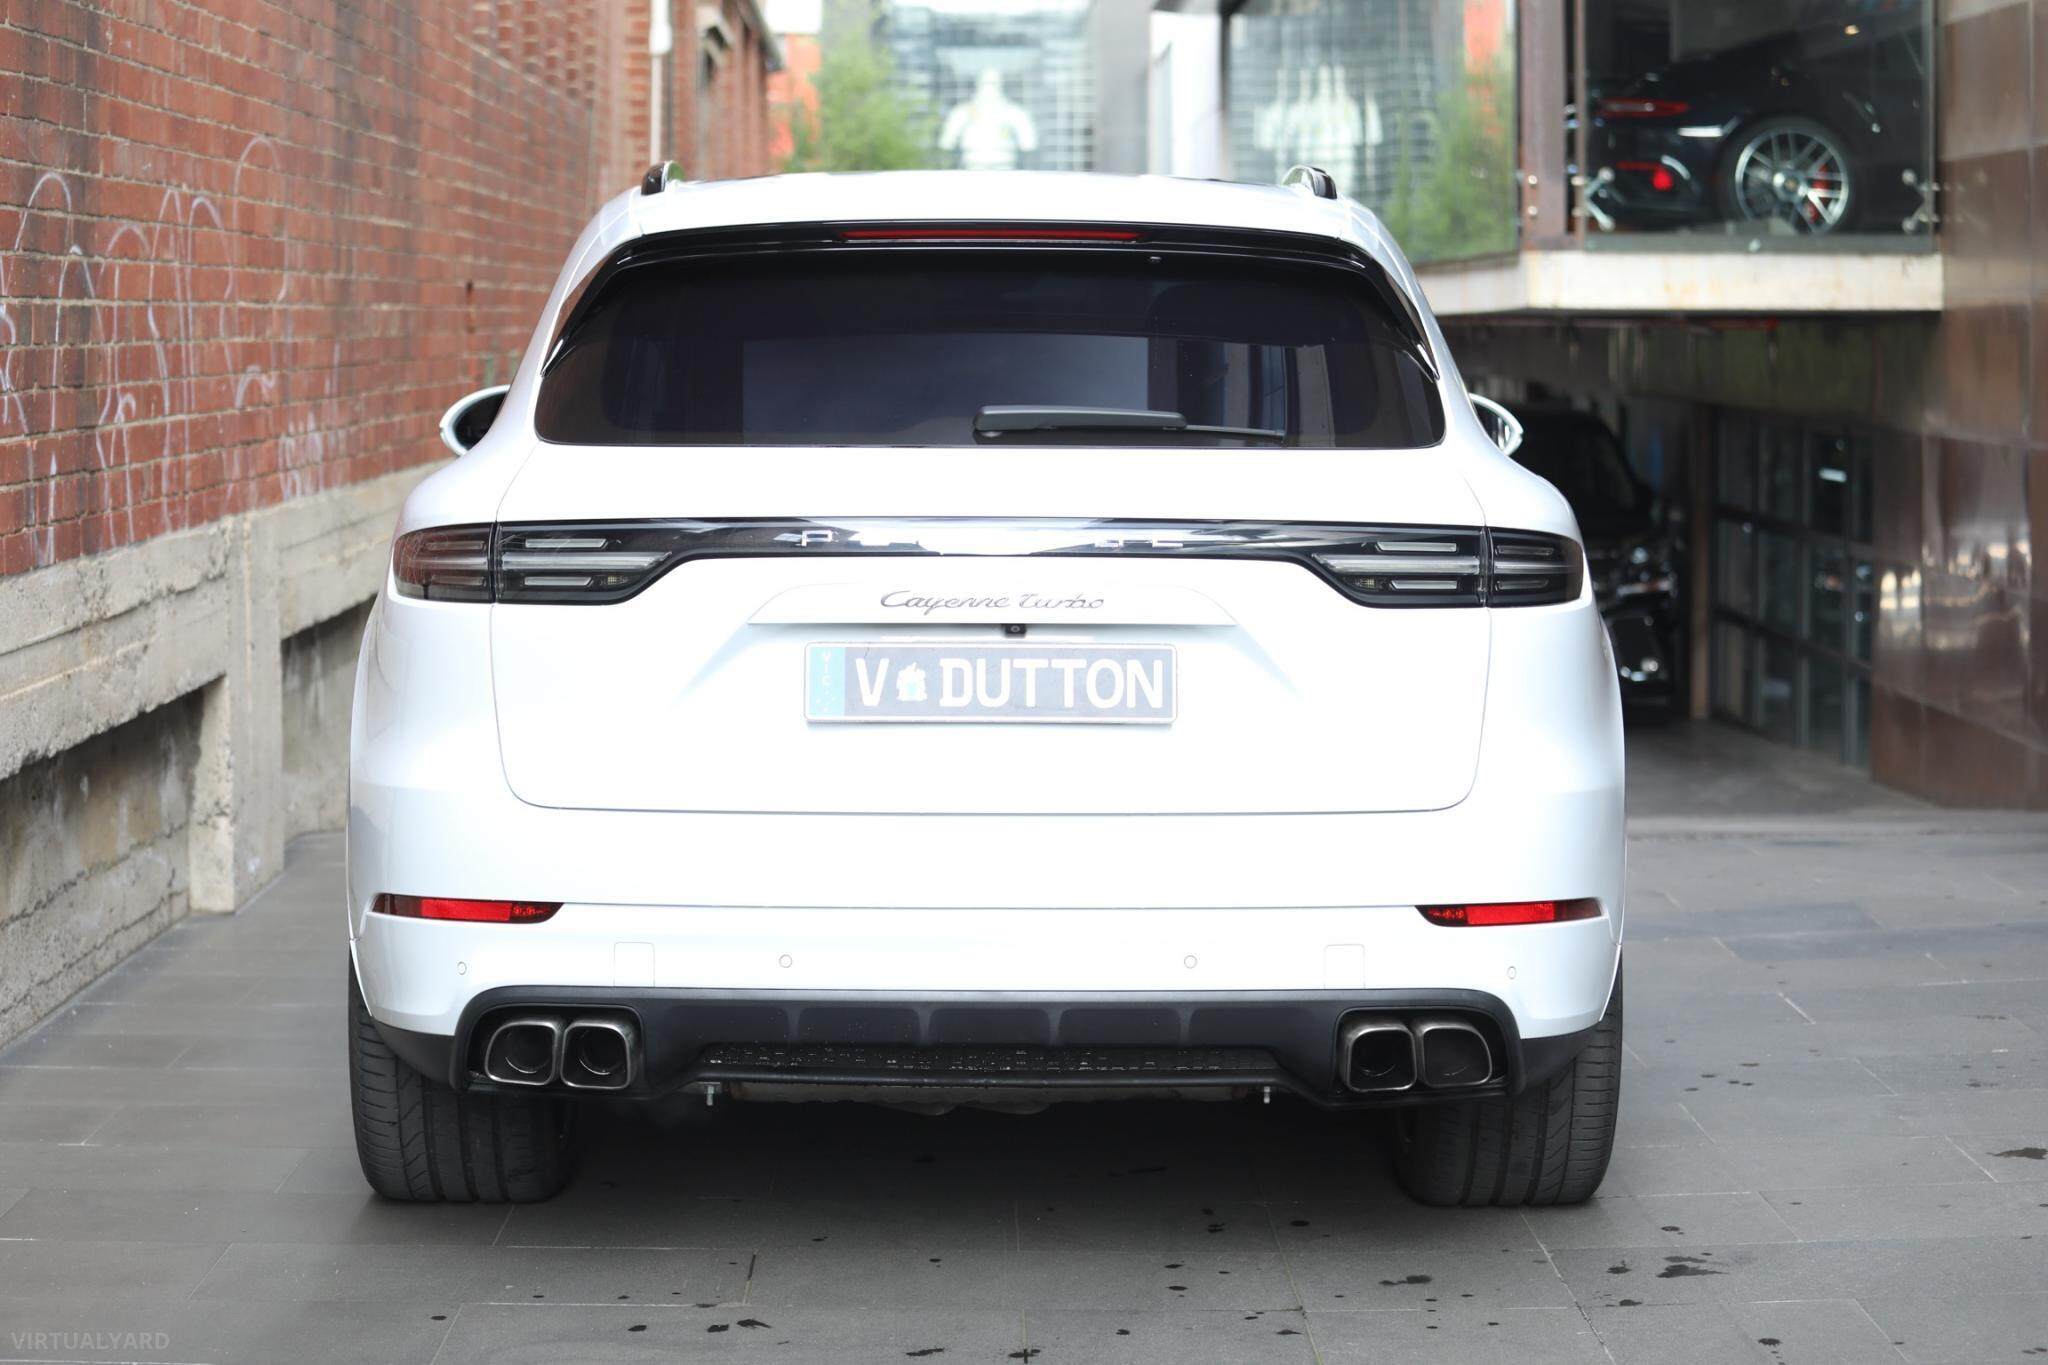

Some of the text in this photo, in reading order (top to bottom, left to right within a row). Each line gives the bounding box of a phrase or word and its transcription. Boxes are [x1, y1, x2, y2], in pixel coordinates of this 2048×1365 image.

[880, 590, 1105, 616] Cayenne Turbo
[855, 658, 1164, 709] V DUTTON
